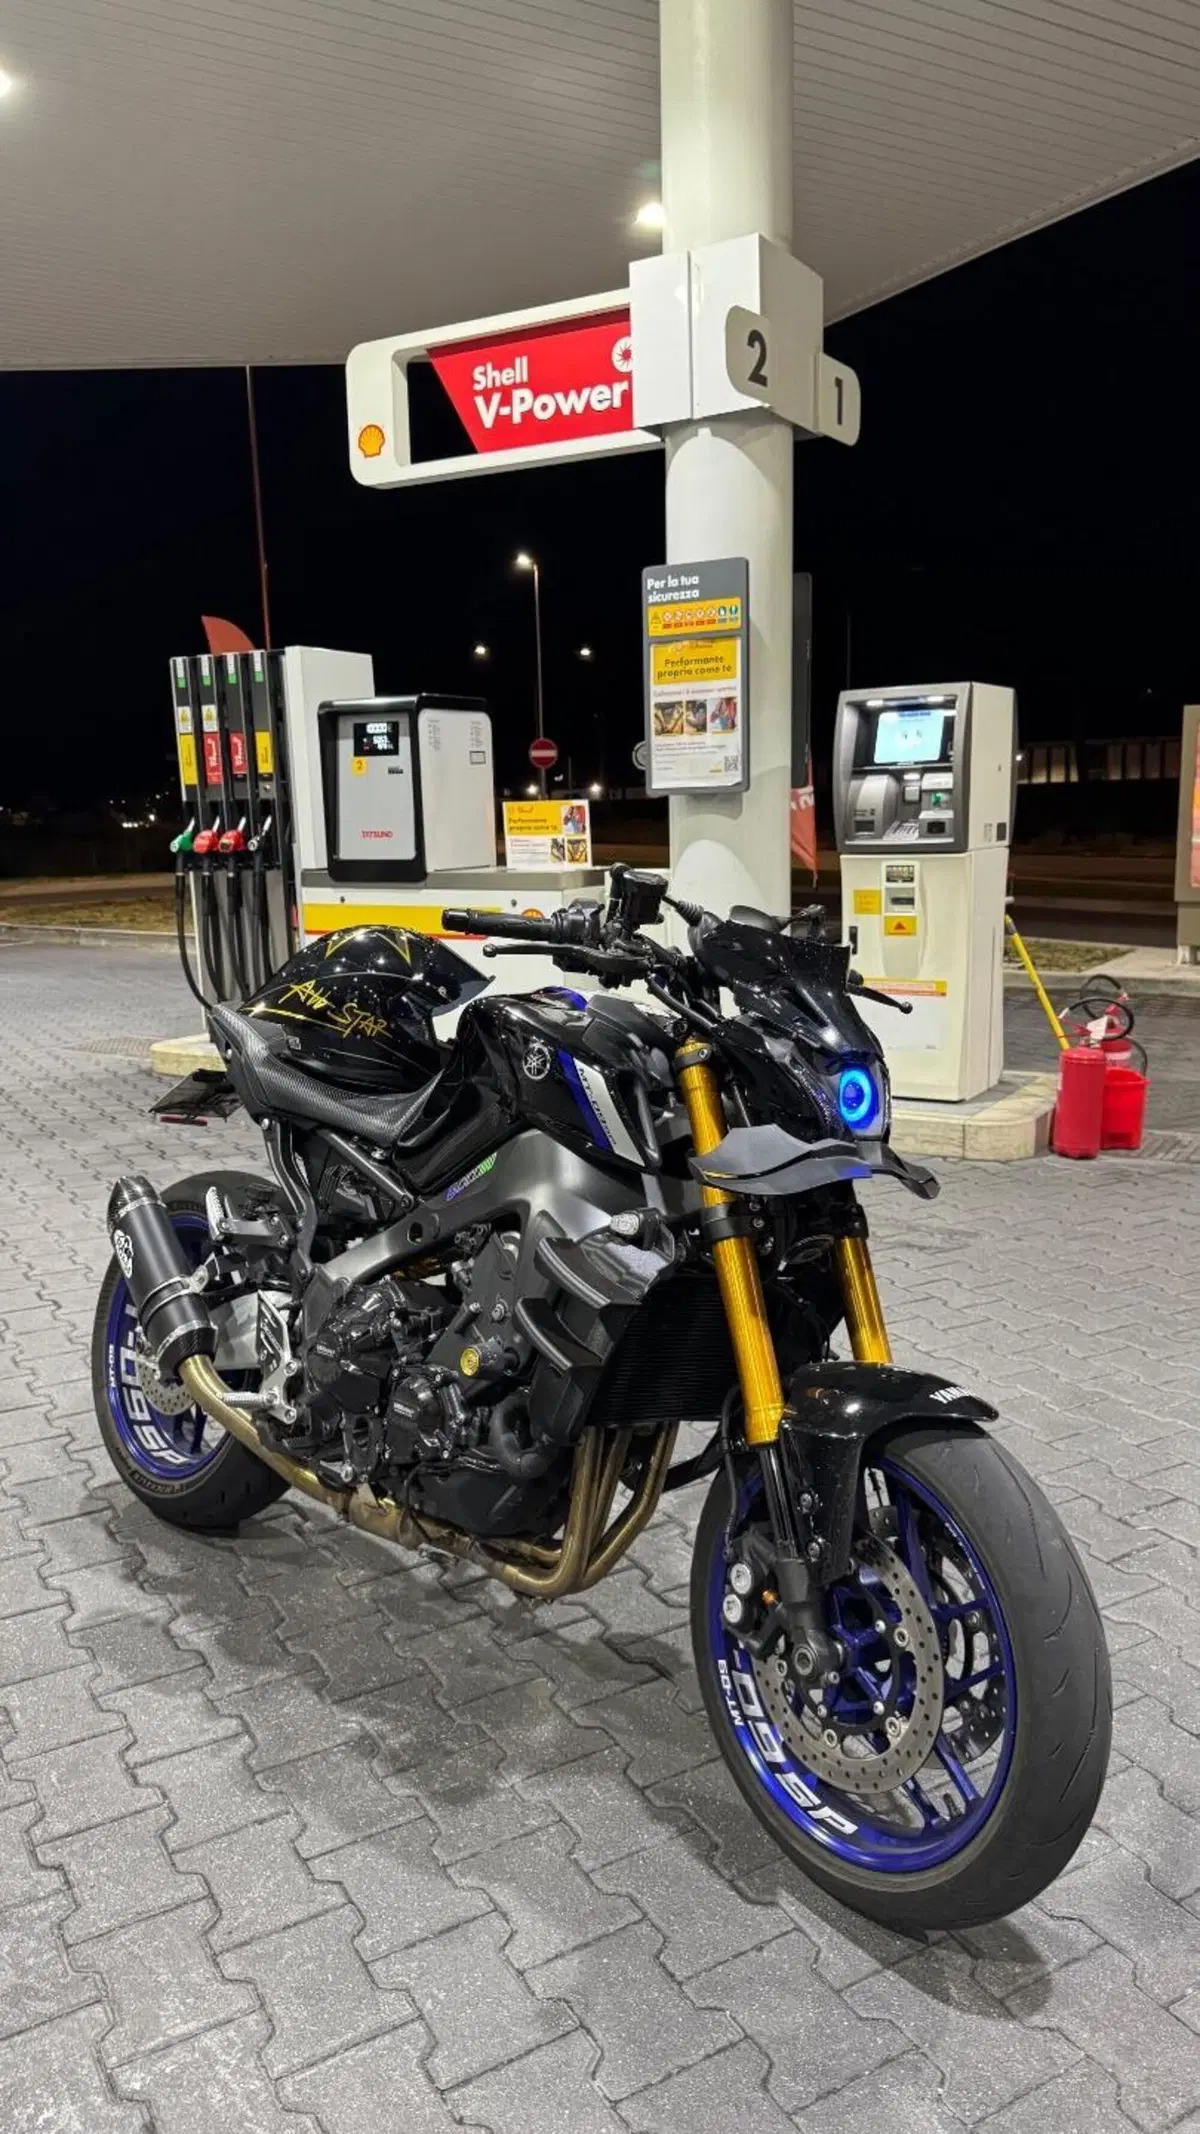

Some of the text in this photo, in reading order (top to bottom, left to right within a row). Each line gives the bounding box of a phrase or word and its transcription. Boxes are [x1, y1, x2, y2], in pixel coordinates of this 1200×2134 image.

[473, 355, 528, 391] Shell
[746, 329, 768, 387] 2
[473, 379, 630, 429] V-Power
[834, 377, 844, 425] 1
[646, 574, 700, 590] Per la tua
[647, 589, 700, 603] sicurezza
[664, 655, 724, 667] Performante
[717, 1659, 745, 1726] MT-09
